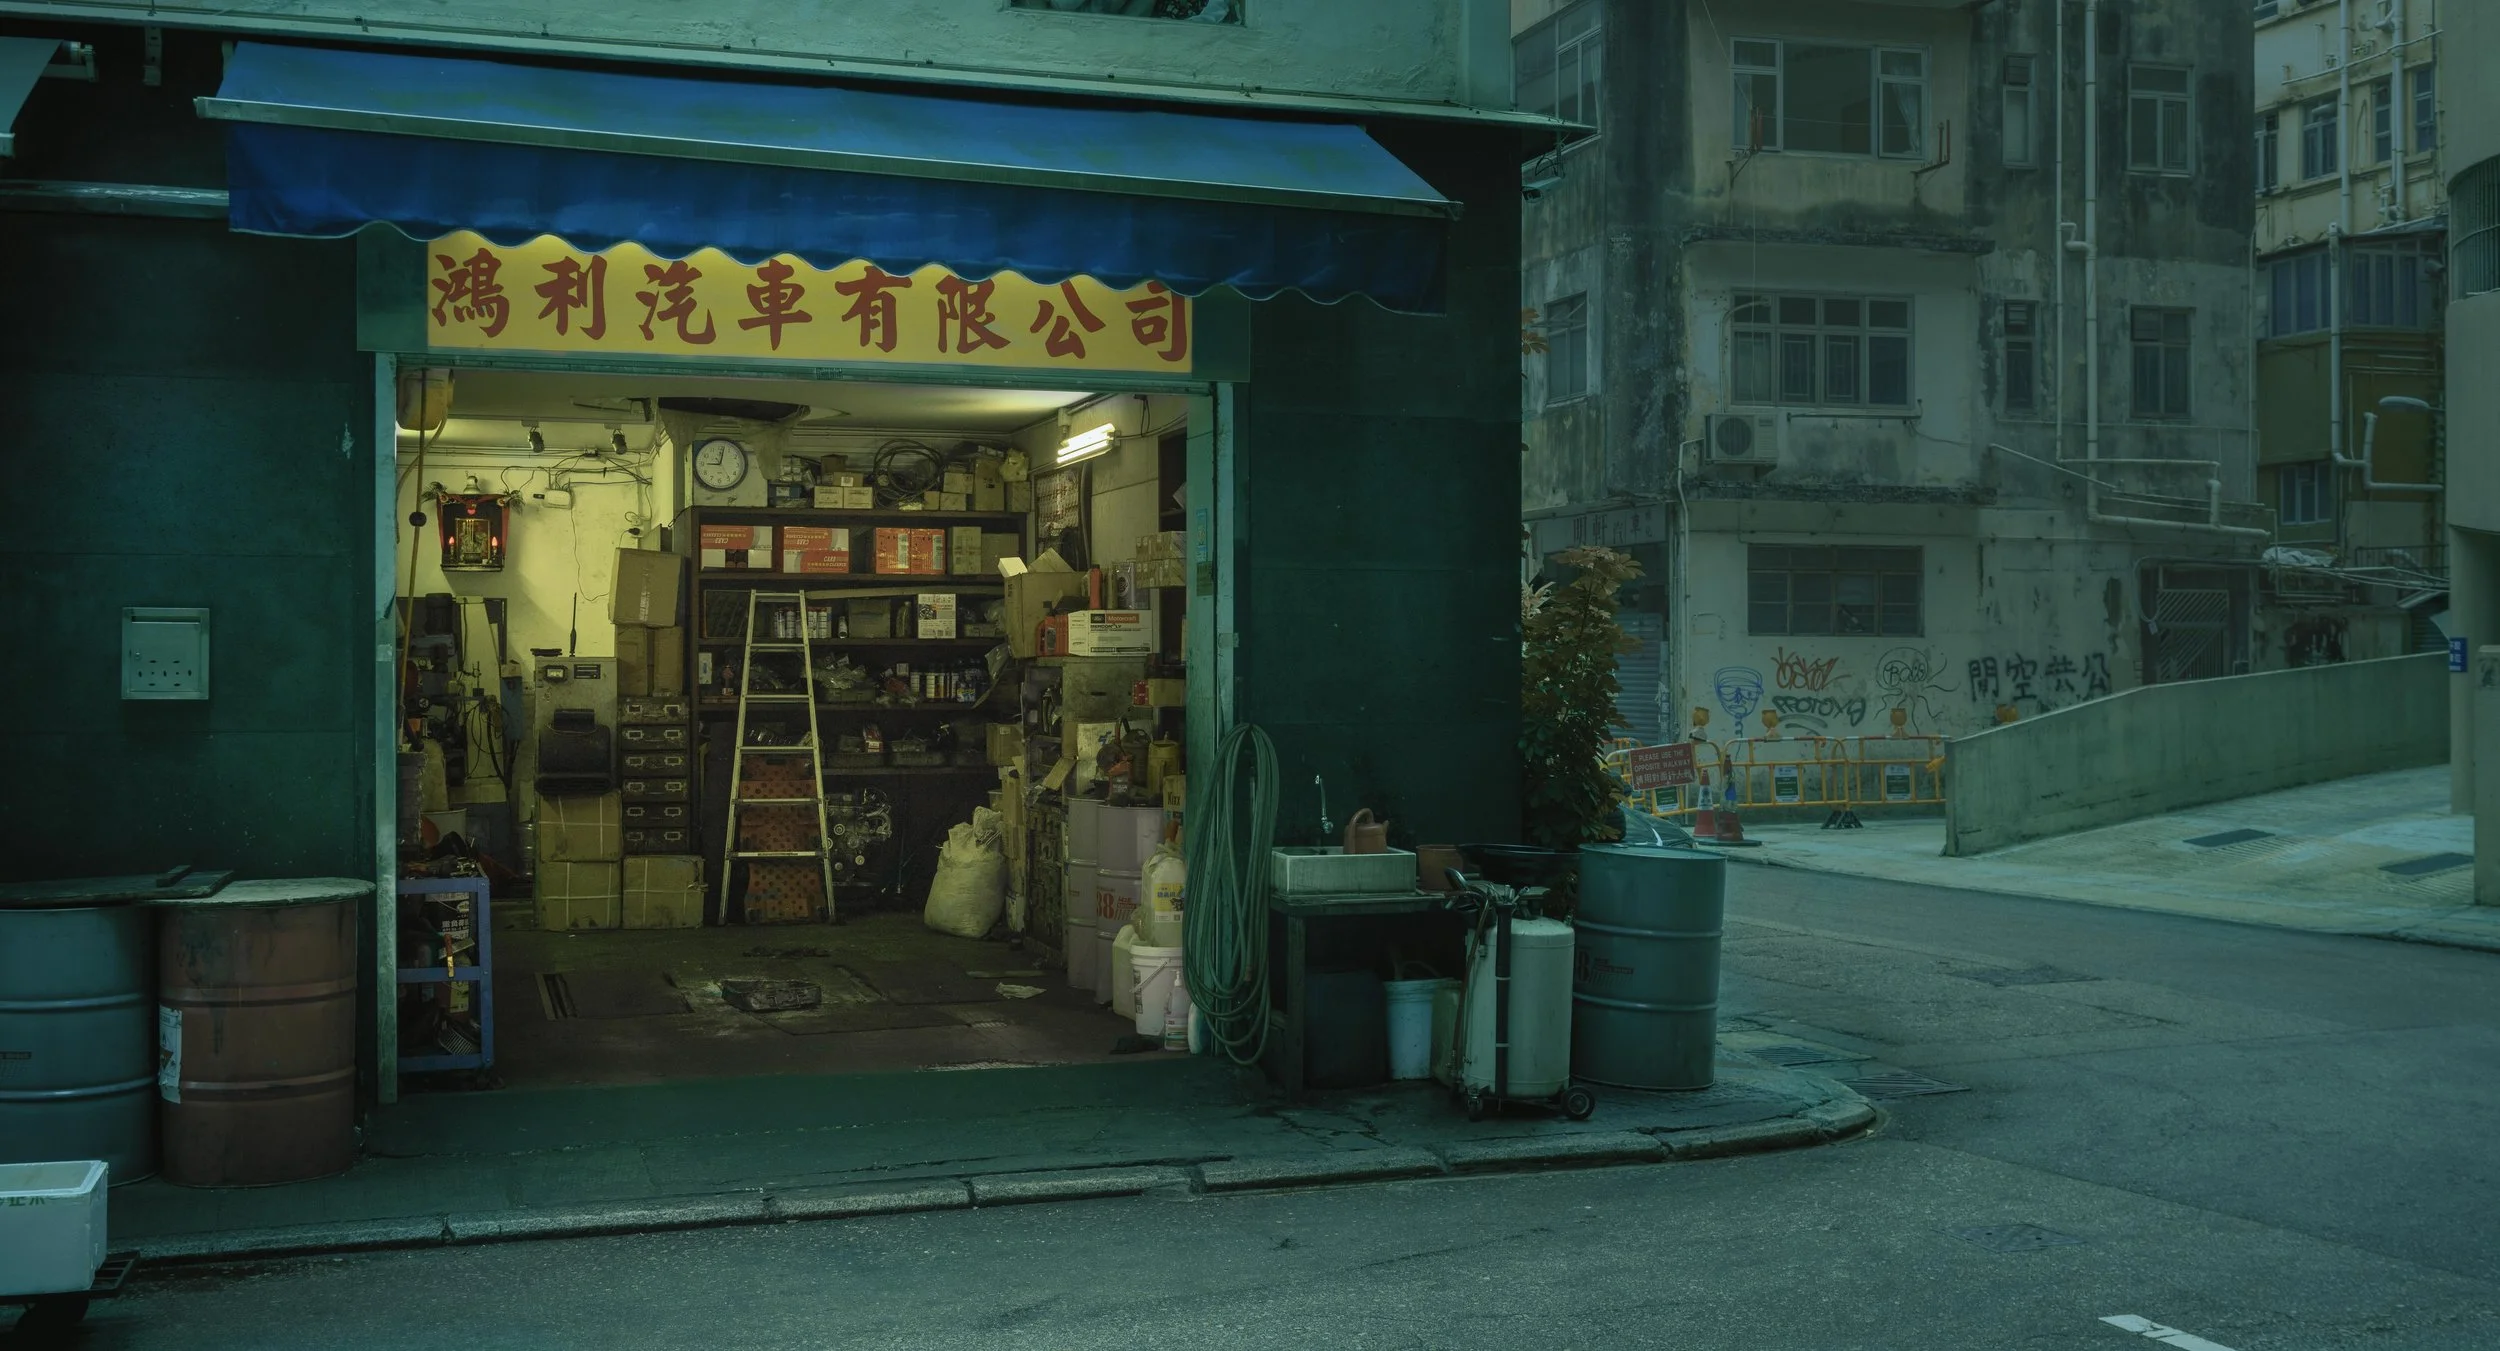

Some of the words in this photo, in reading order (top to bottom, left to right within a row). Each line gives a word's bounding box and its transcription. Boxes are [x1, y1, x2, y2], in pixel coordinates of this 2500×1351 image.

[431, 248, 1189, 362] 鴻利汽車有限公司
[1638, 753, 1659, 761] PLEASE
[1661, 751, 1673, 759] USE
[1673, 749, 1684, 757] THE
[1634, 762, 1661, 772] OPPOSITE
[1663, 759, 1690, 768] WALKWAY
